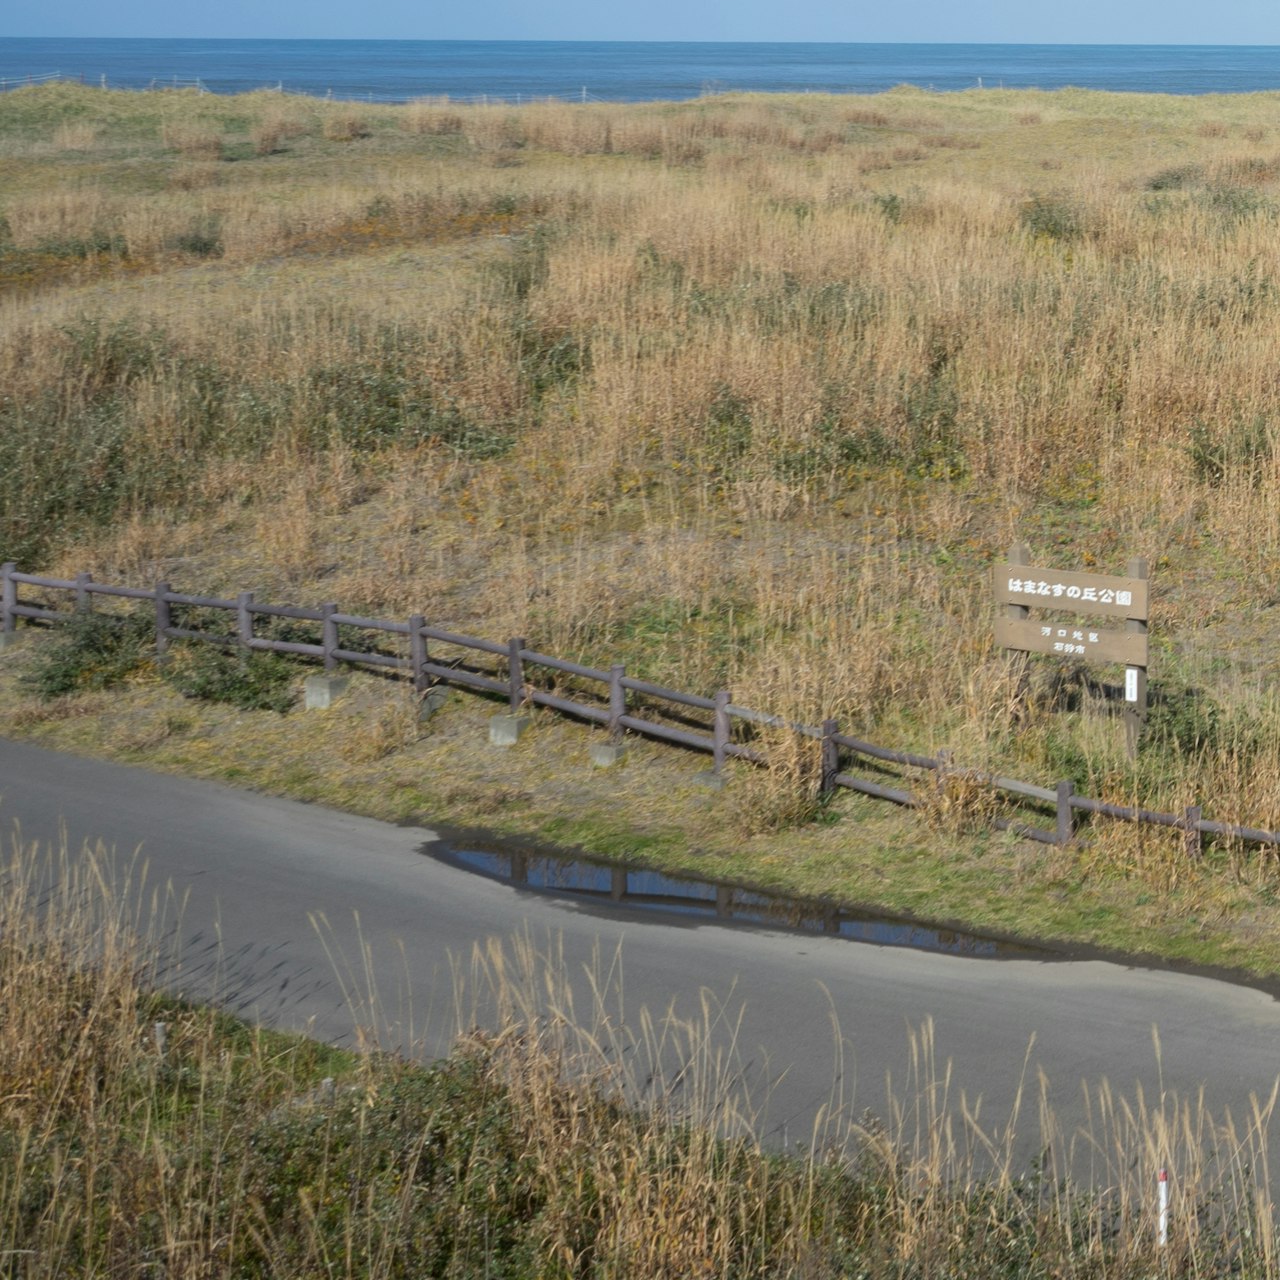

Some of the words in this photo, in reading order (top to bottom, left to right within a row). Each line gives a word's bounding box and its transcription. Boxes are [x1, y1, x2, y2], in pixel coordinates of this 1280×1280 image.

[1008, 578, 1132, 606] はまなすの丘公園
